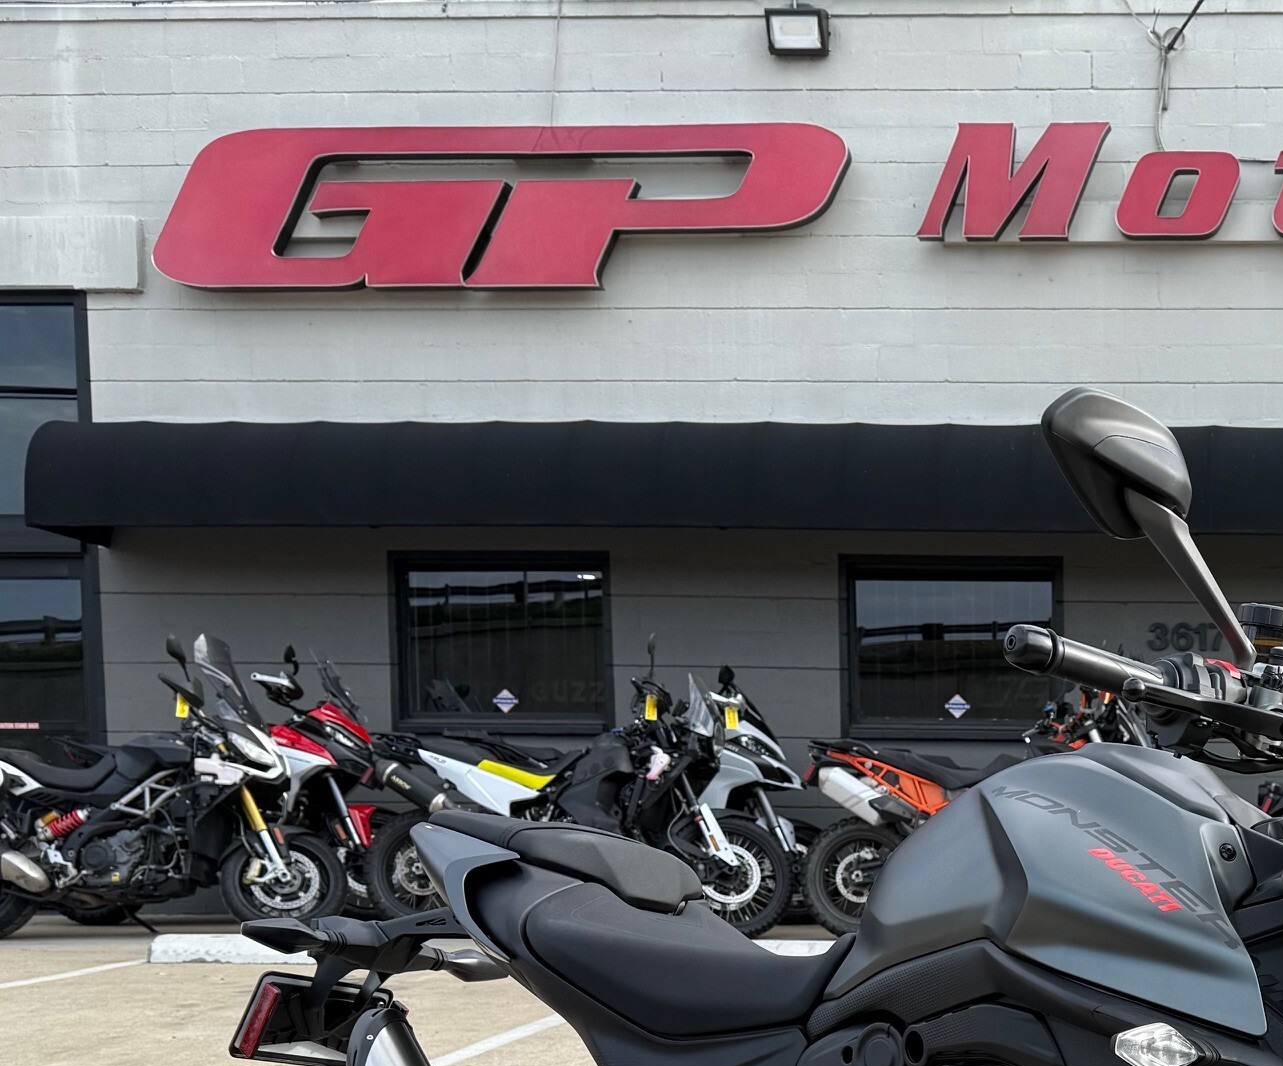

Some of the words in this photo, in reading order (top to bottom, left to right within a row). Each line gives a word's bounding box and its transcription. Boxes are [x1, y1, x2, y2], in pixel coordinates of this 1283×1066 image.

[151, 121, 852, 291] GP
[1147, 622, 1224, 652] 3617
[1088, 847, 1184, 913] DUCATI
